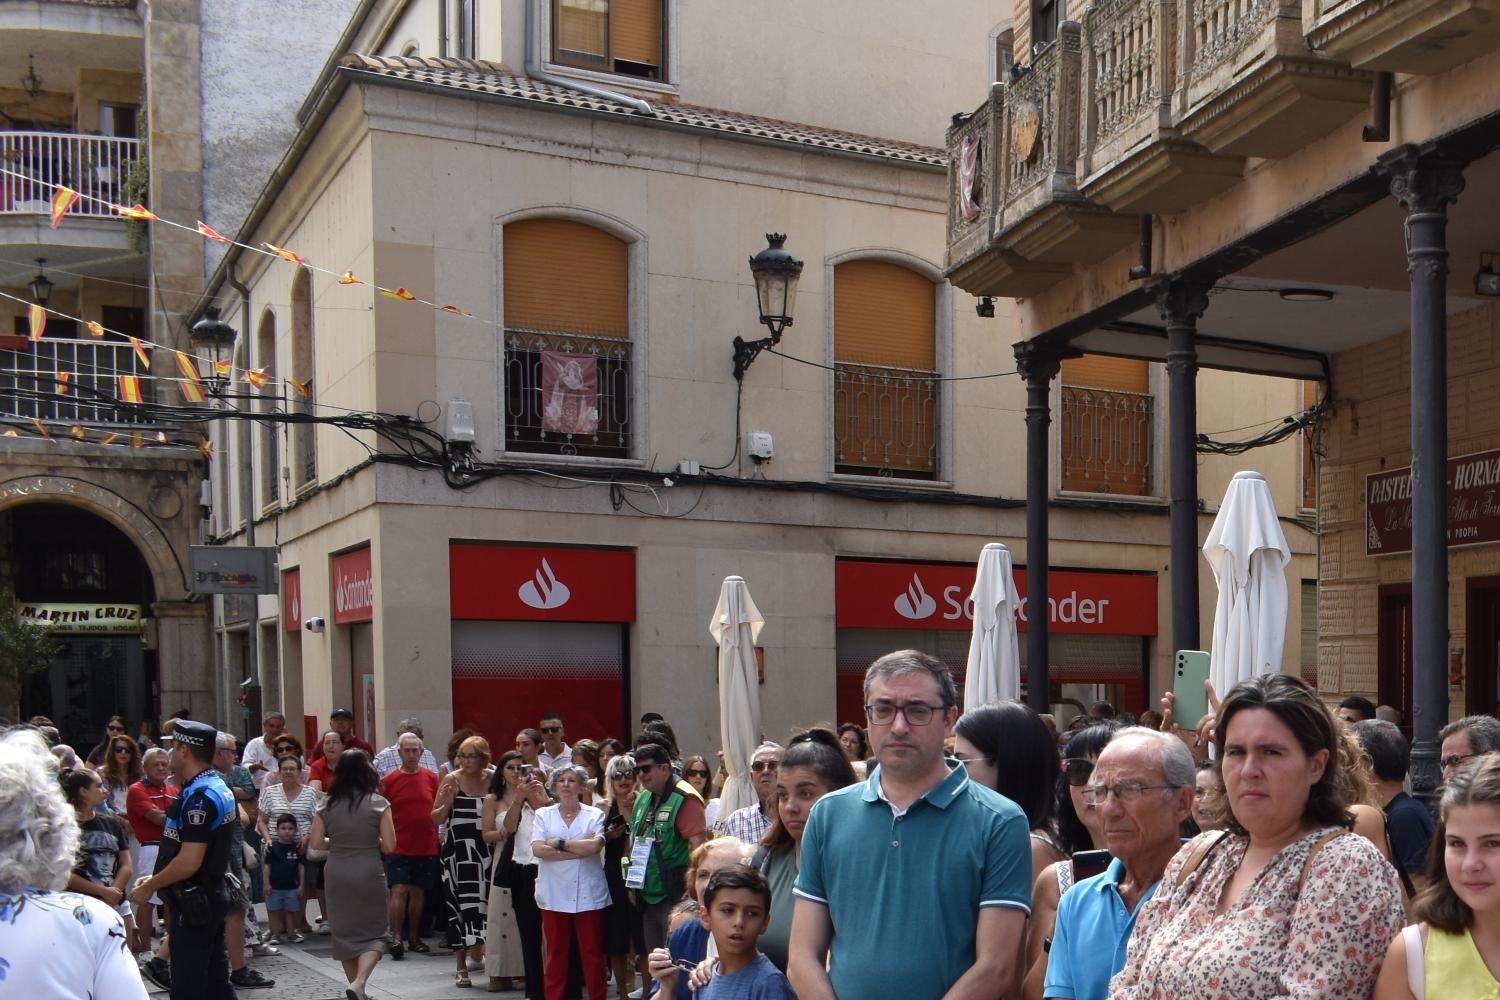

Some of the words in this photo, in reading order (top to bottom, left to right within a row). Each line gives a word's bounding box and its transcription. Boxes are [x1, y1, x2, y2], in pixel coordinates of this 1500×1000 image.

[1455, 526, 1478, 538] PROPIA
[343, 570, 373, 611] Santande
[20, 606, 90, 622] MARTIN
[95, 607, 137, 620] CRUZ
